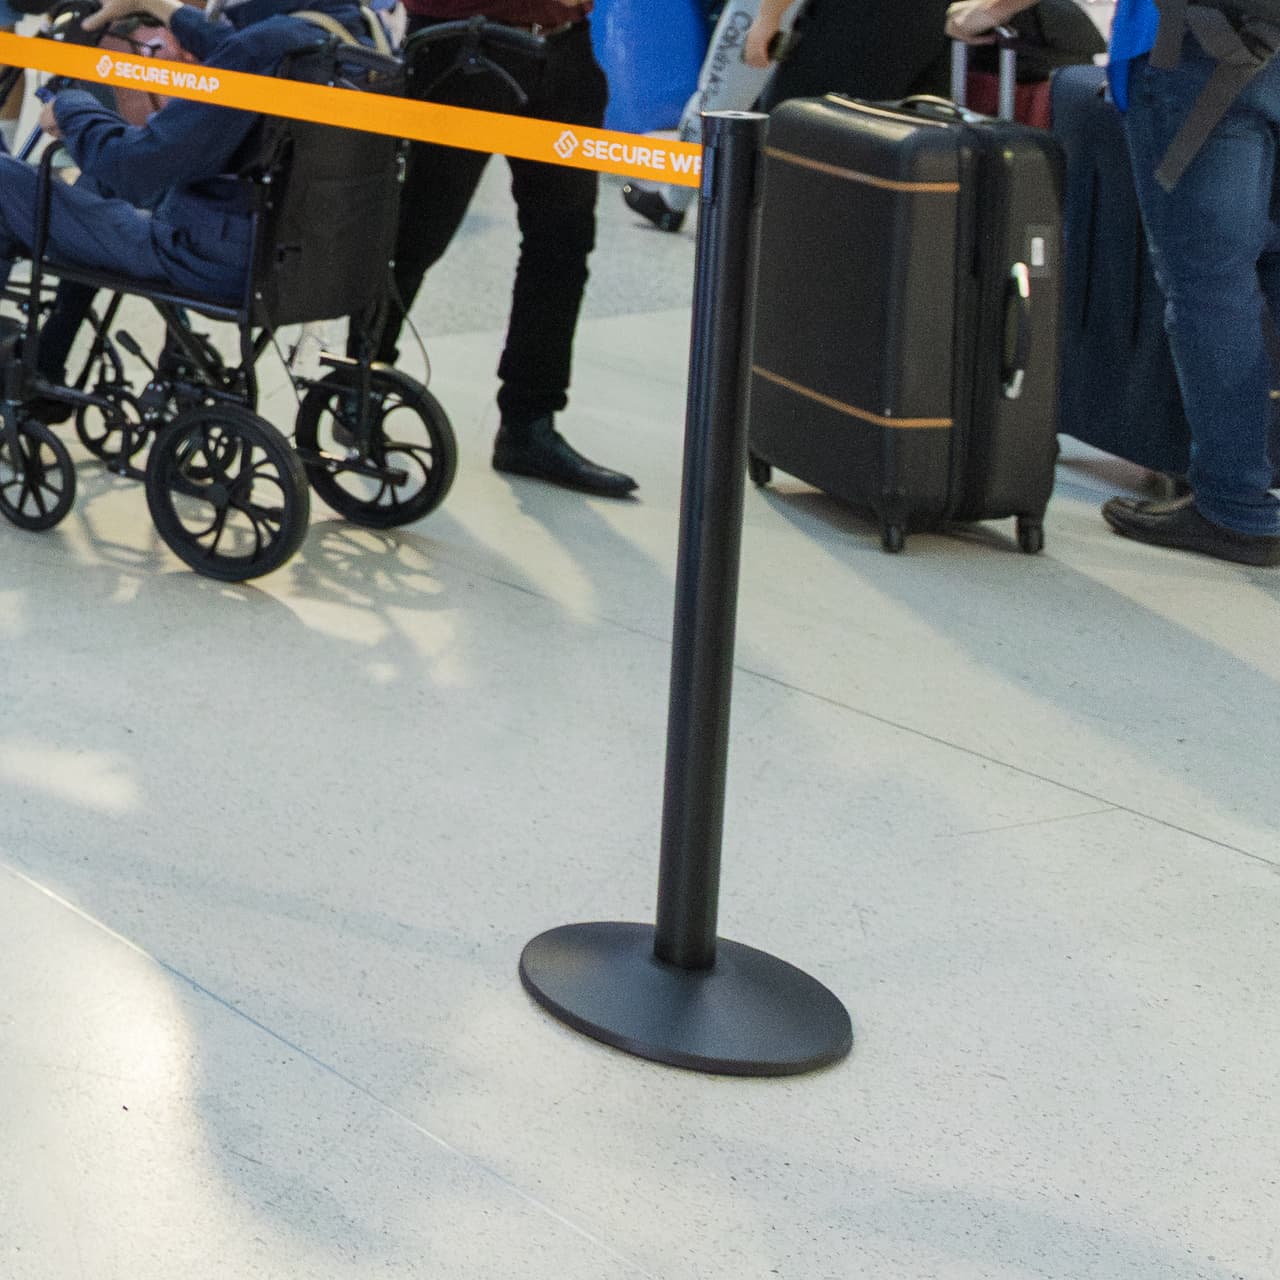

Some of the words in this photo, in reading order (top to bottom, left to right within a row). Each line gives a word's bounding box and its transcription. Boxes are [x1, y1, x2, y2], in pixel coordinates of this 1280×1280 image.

[115, 61, 170, 85] SECURE
[171, 71, 220, 93] WRAP
[582, 138, 666, 170] SECURE
